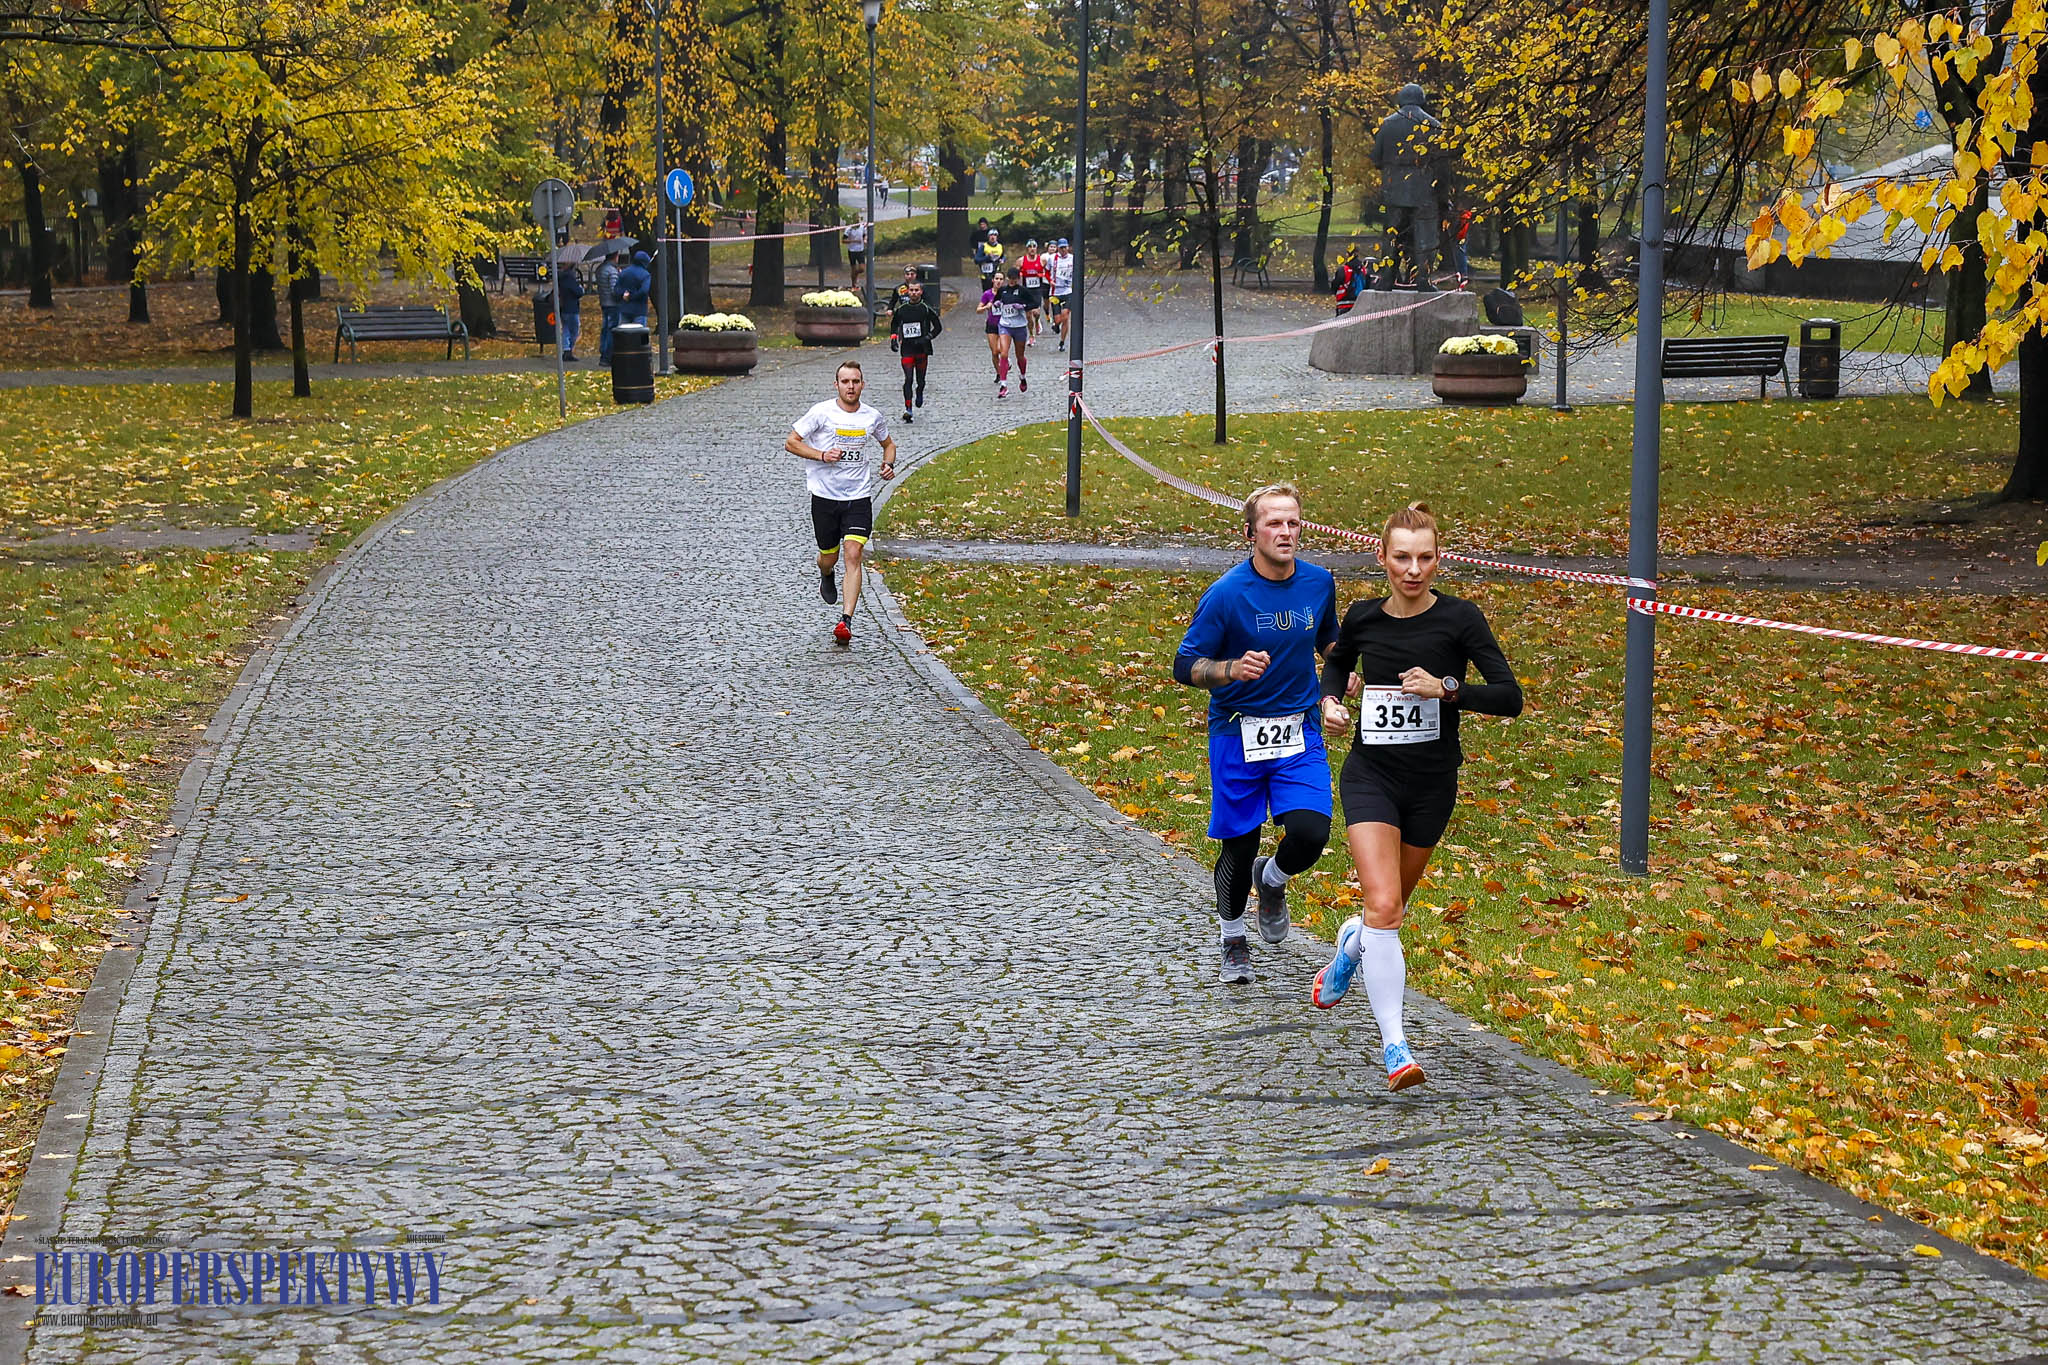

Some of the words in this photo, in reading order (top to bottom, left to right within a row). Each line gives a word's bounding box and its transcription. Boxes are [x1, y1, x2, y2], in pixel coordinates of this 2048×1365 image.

[840, 450, 861, 461] 253
[1256, 607, 1310, 633] RUN
[1374, 704, 1423, 729] 354
[1256, 724, 1292, 746] 624
